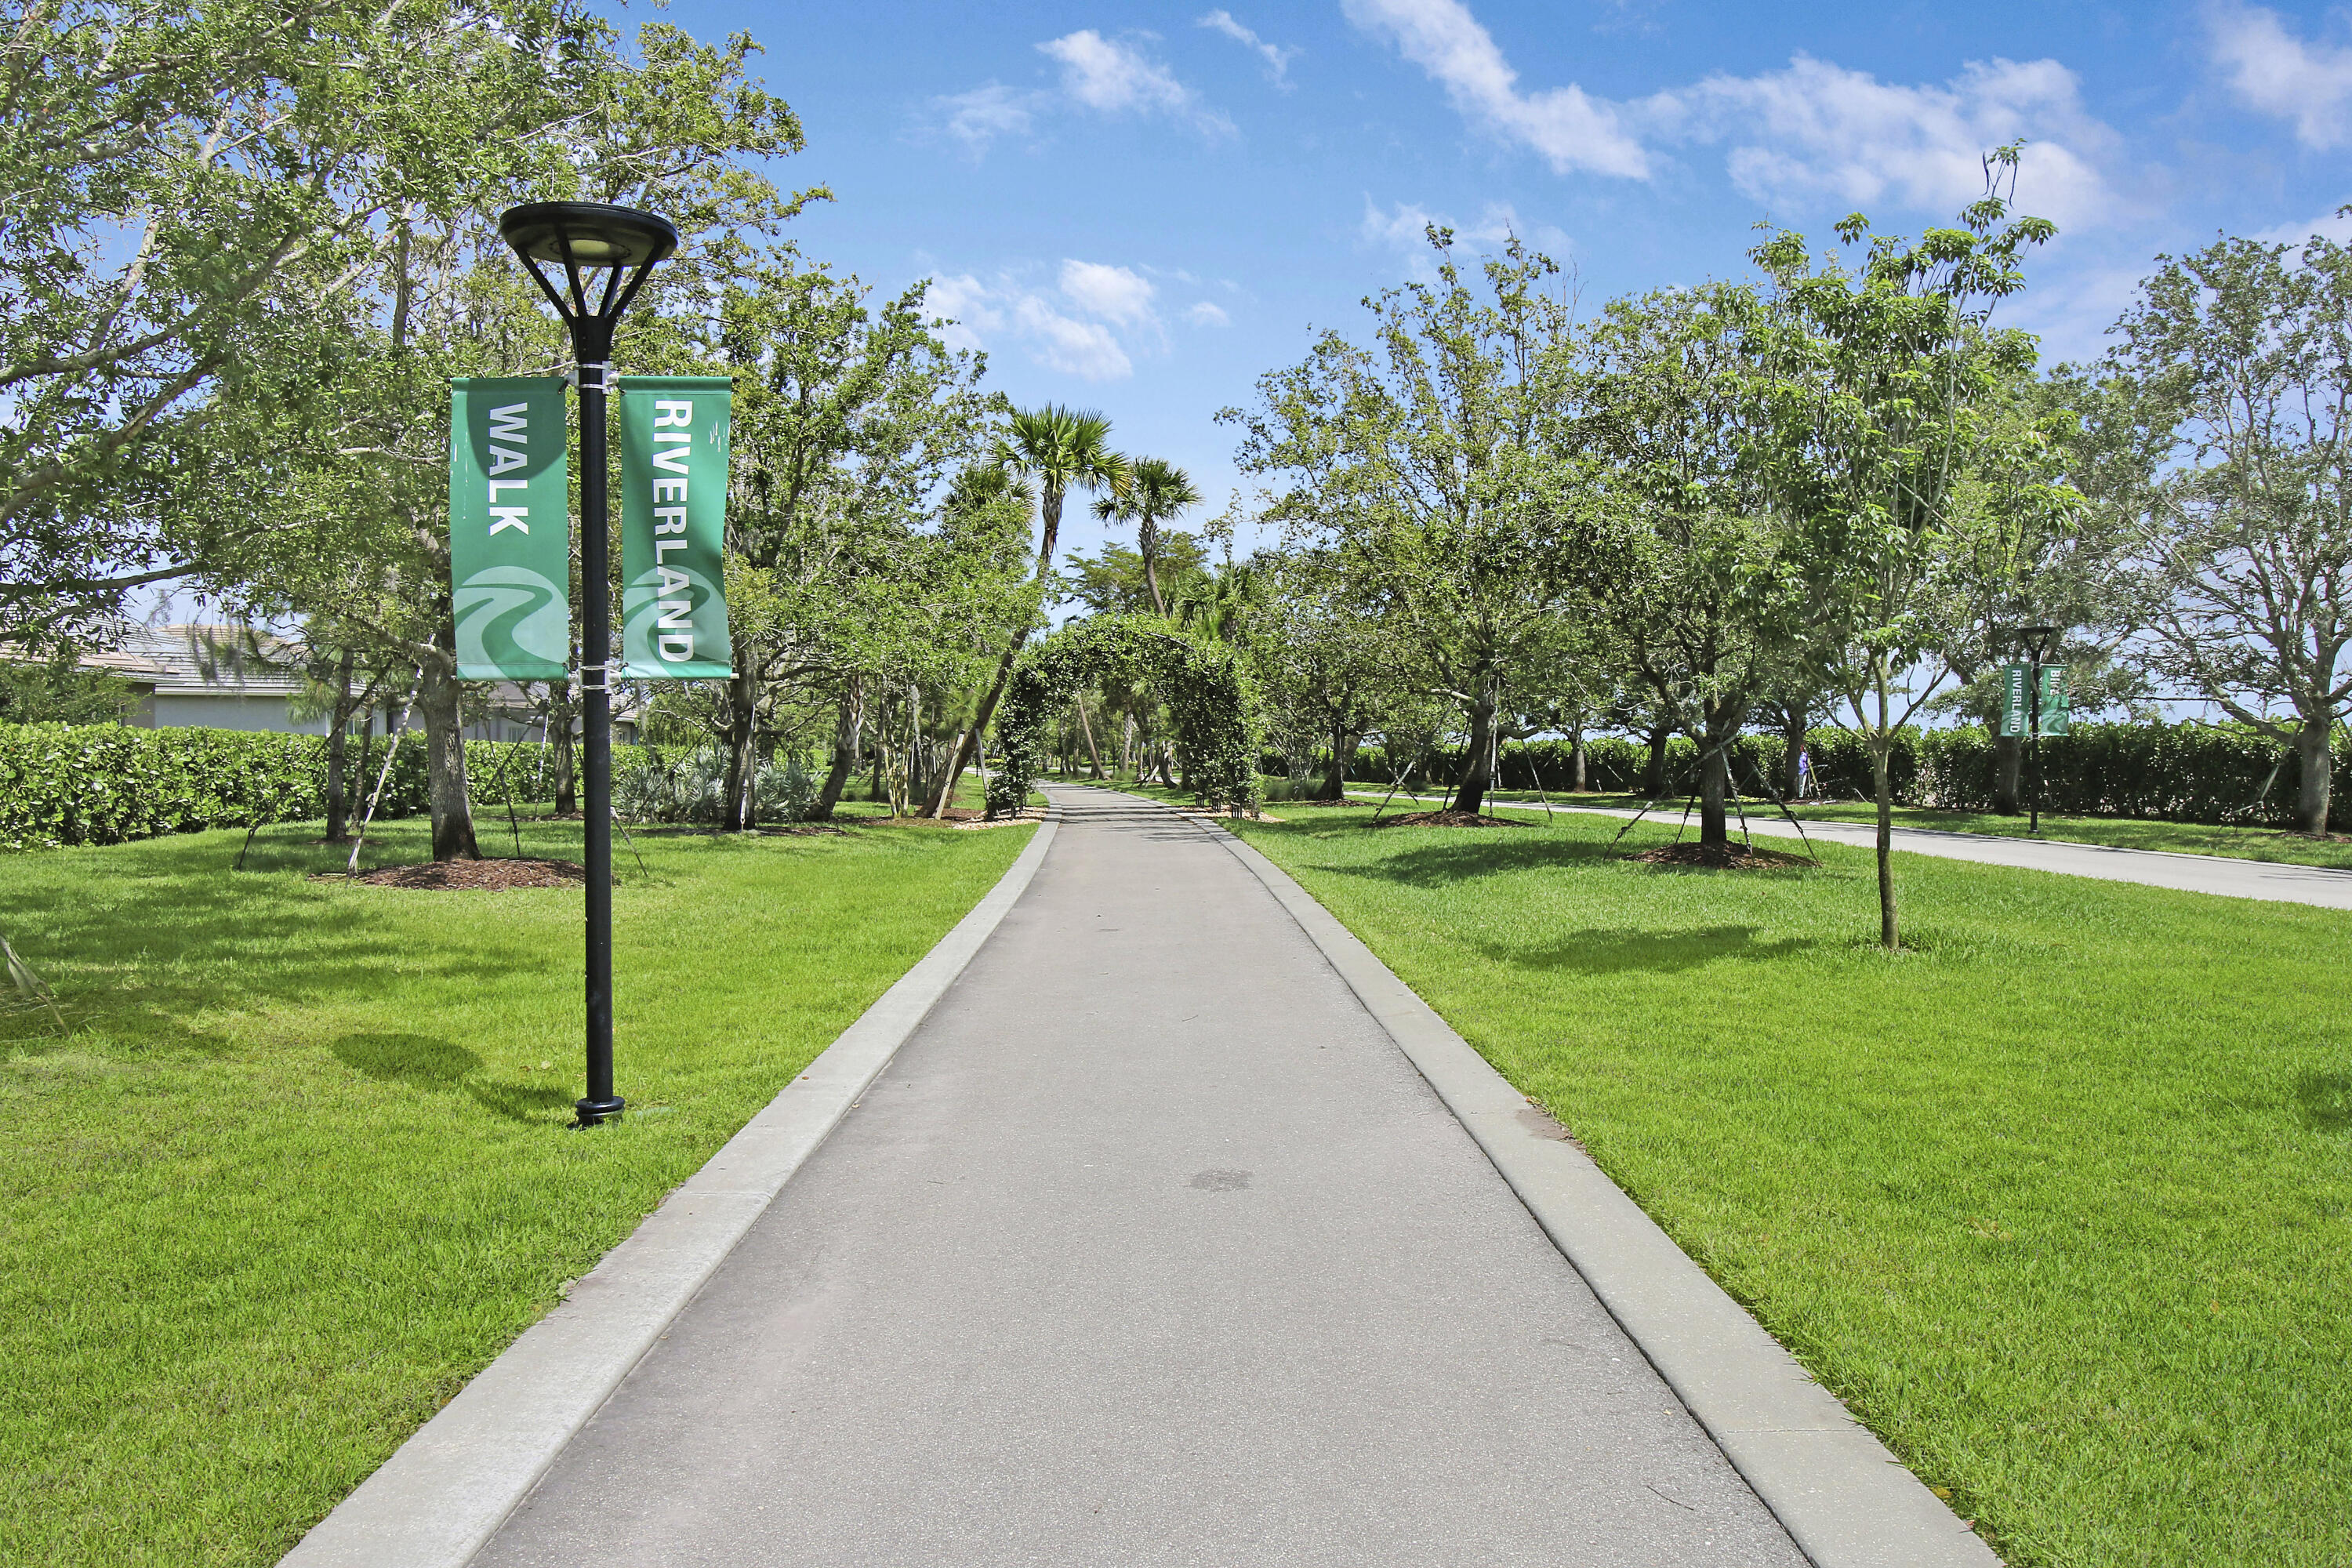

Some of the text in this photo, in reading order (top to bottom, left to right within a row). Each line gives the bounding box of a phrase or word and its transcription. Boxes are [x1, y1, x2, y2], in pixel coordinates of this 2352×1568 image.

[489, 401, 529, 536] WALK
[652, 399, 694, 662] RIVERLAND
[2009, 670, 2022, 733] RIVERLAND
